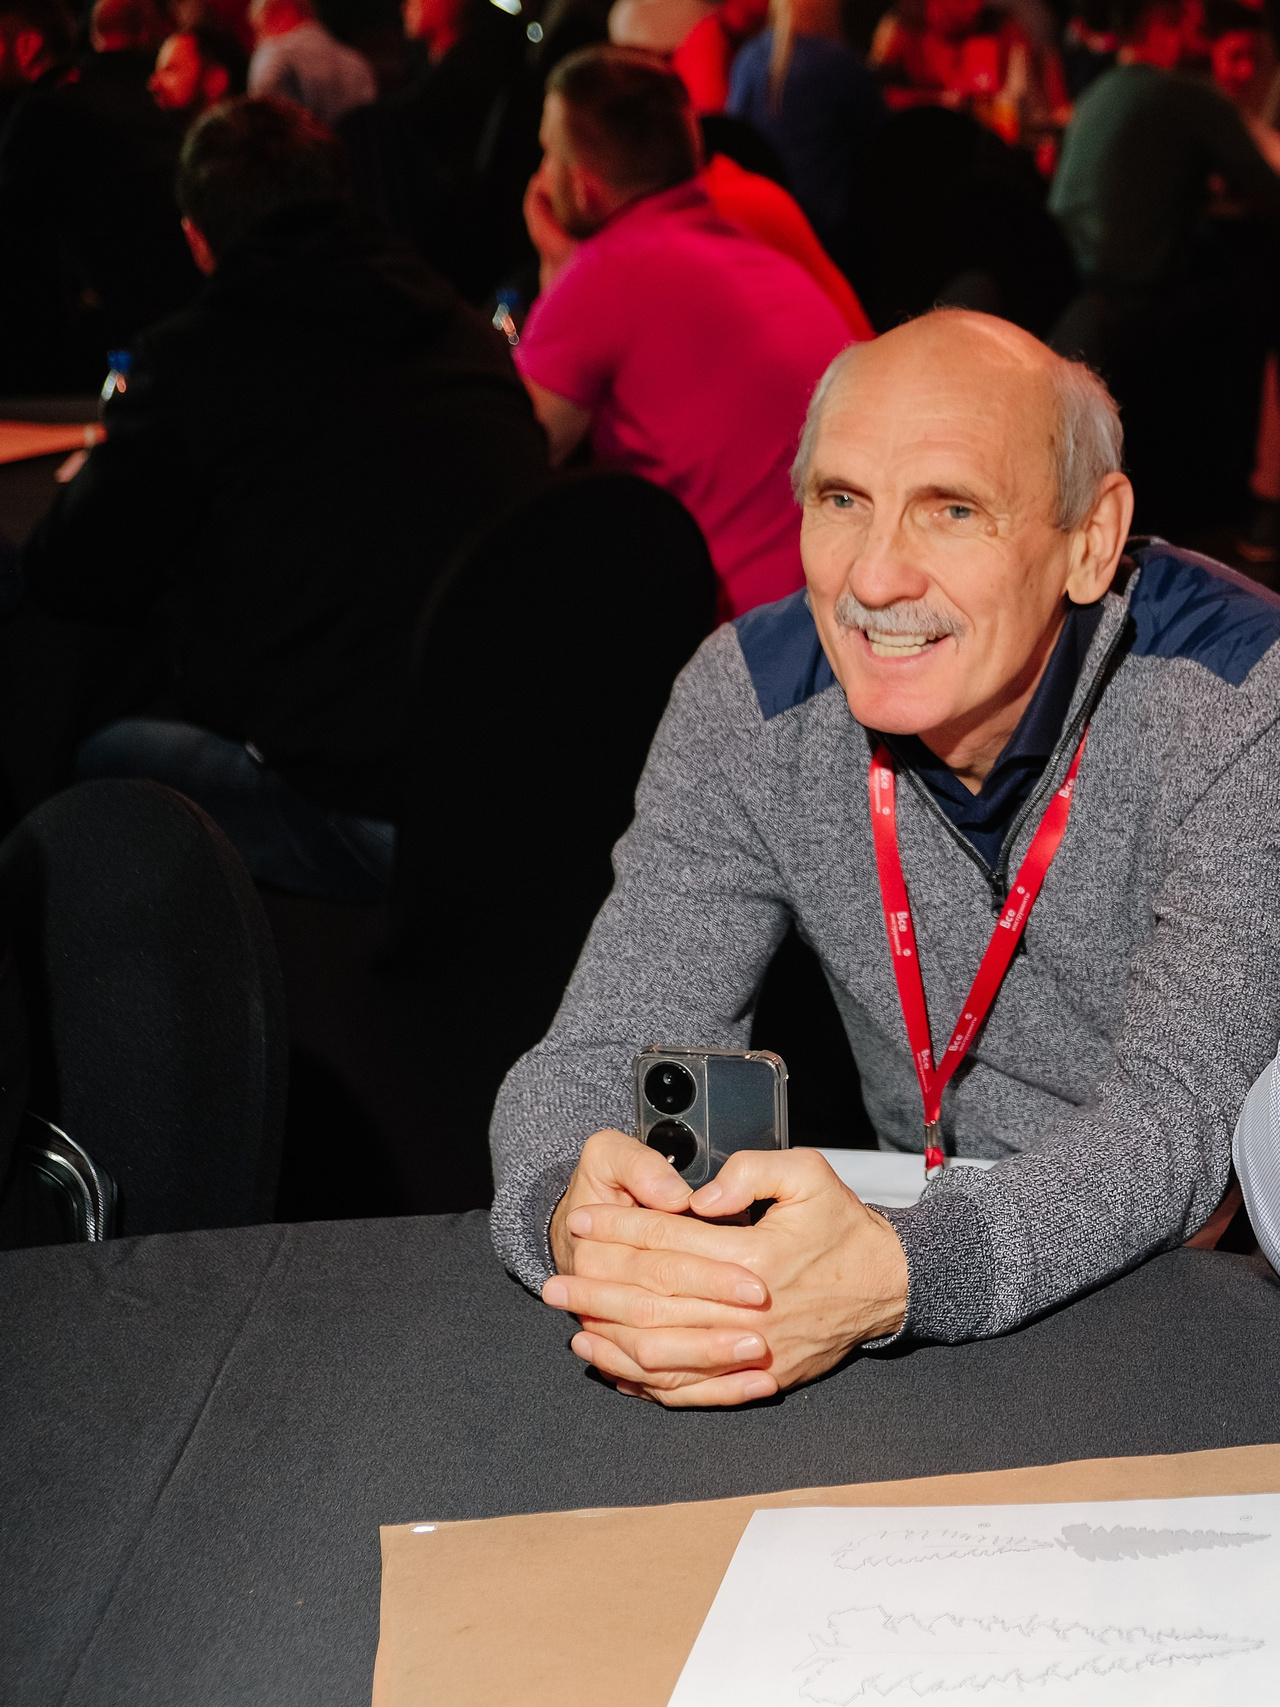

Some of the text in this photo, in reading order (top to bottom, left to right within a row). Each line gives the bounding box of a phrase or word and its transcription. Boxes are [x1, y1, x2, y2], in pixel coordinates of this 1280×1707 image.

[1058, 779, 1075, 798] Все
[896, 911, 909, 932] Все
[1000, 908, 1016, 929] Все
